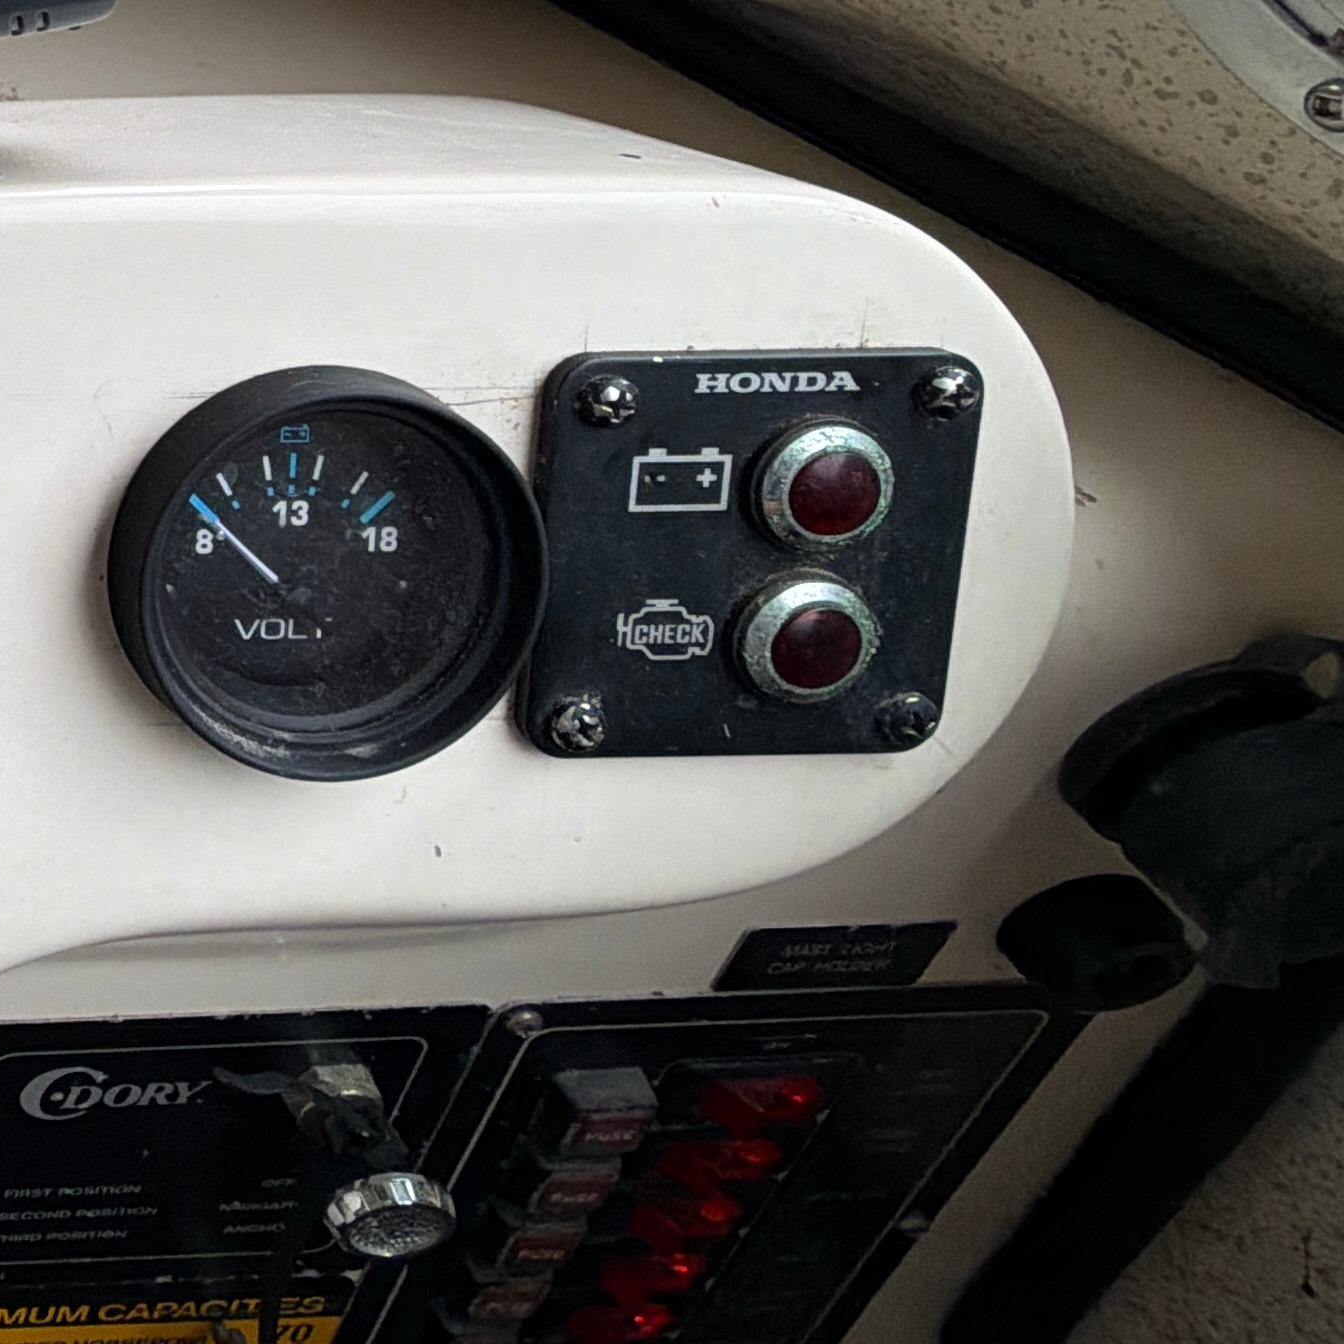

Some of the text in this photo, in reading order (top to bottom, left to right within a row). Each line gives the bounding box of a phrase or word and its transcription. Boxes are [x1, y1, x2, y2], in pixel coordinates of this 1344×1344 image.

[694, 371, 860, 394] HONDA
[272, 501, 310, 527] 13
[195, 529, 213, 555] 8
[361, 527, 399, 552] 18
[634, 623, 706, 644] CHECK
[58, 1184, 143, 1198] POSITION
[76, 1206, 159, 1219] POSITION
[47, 1229, 129, 1241] POSITION
[97, 1296, 327, 1323] CAPACITES
